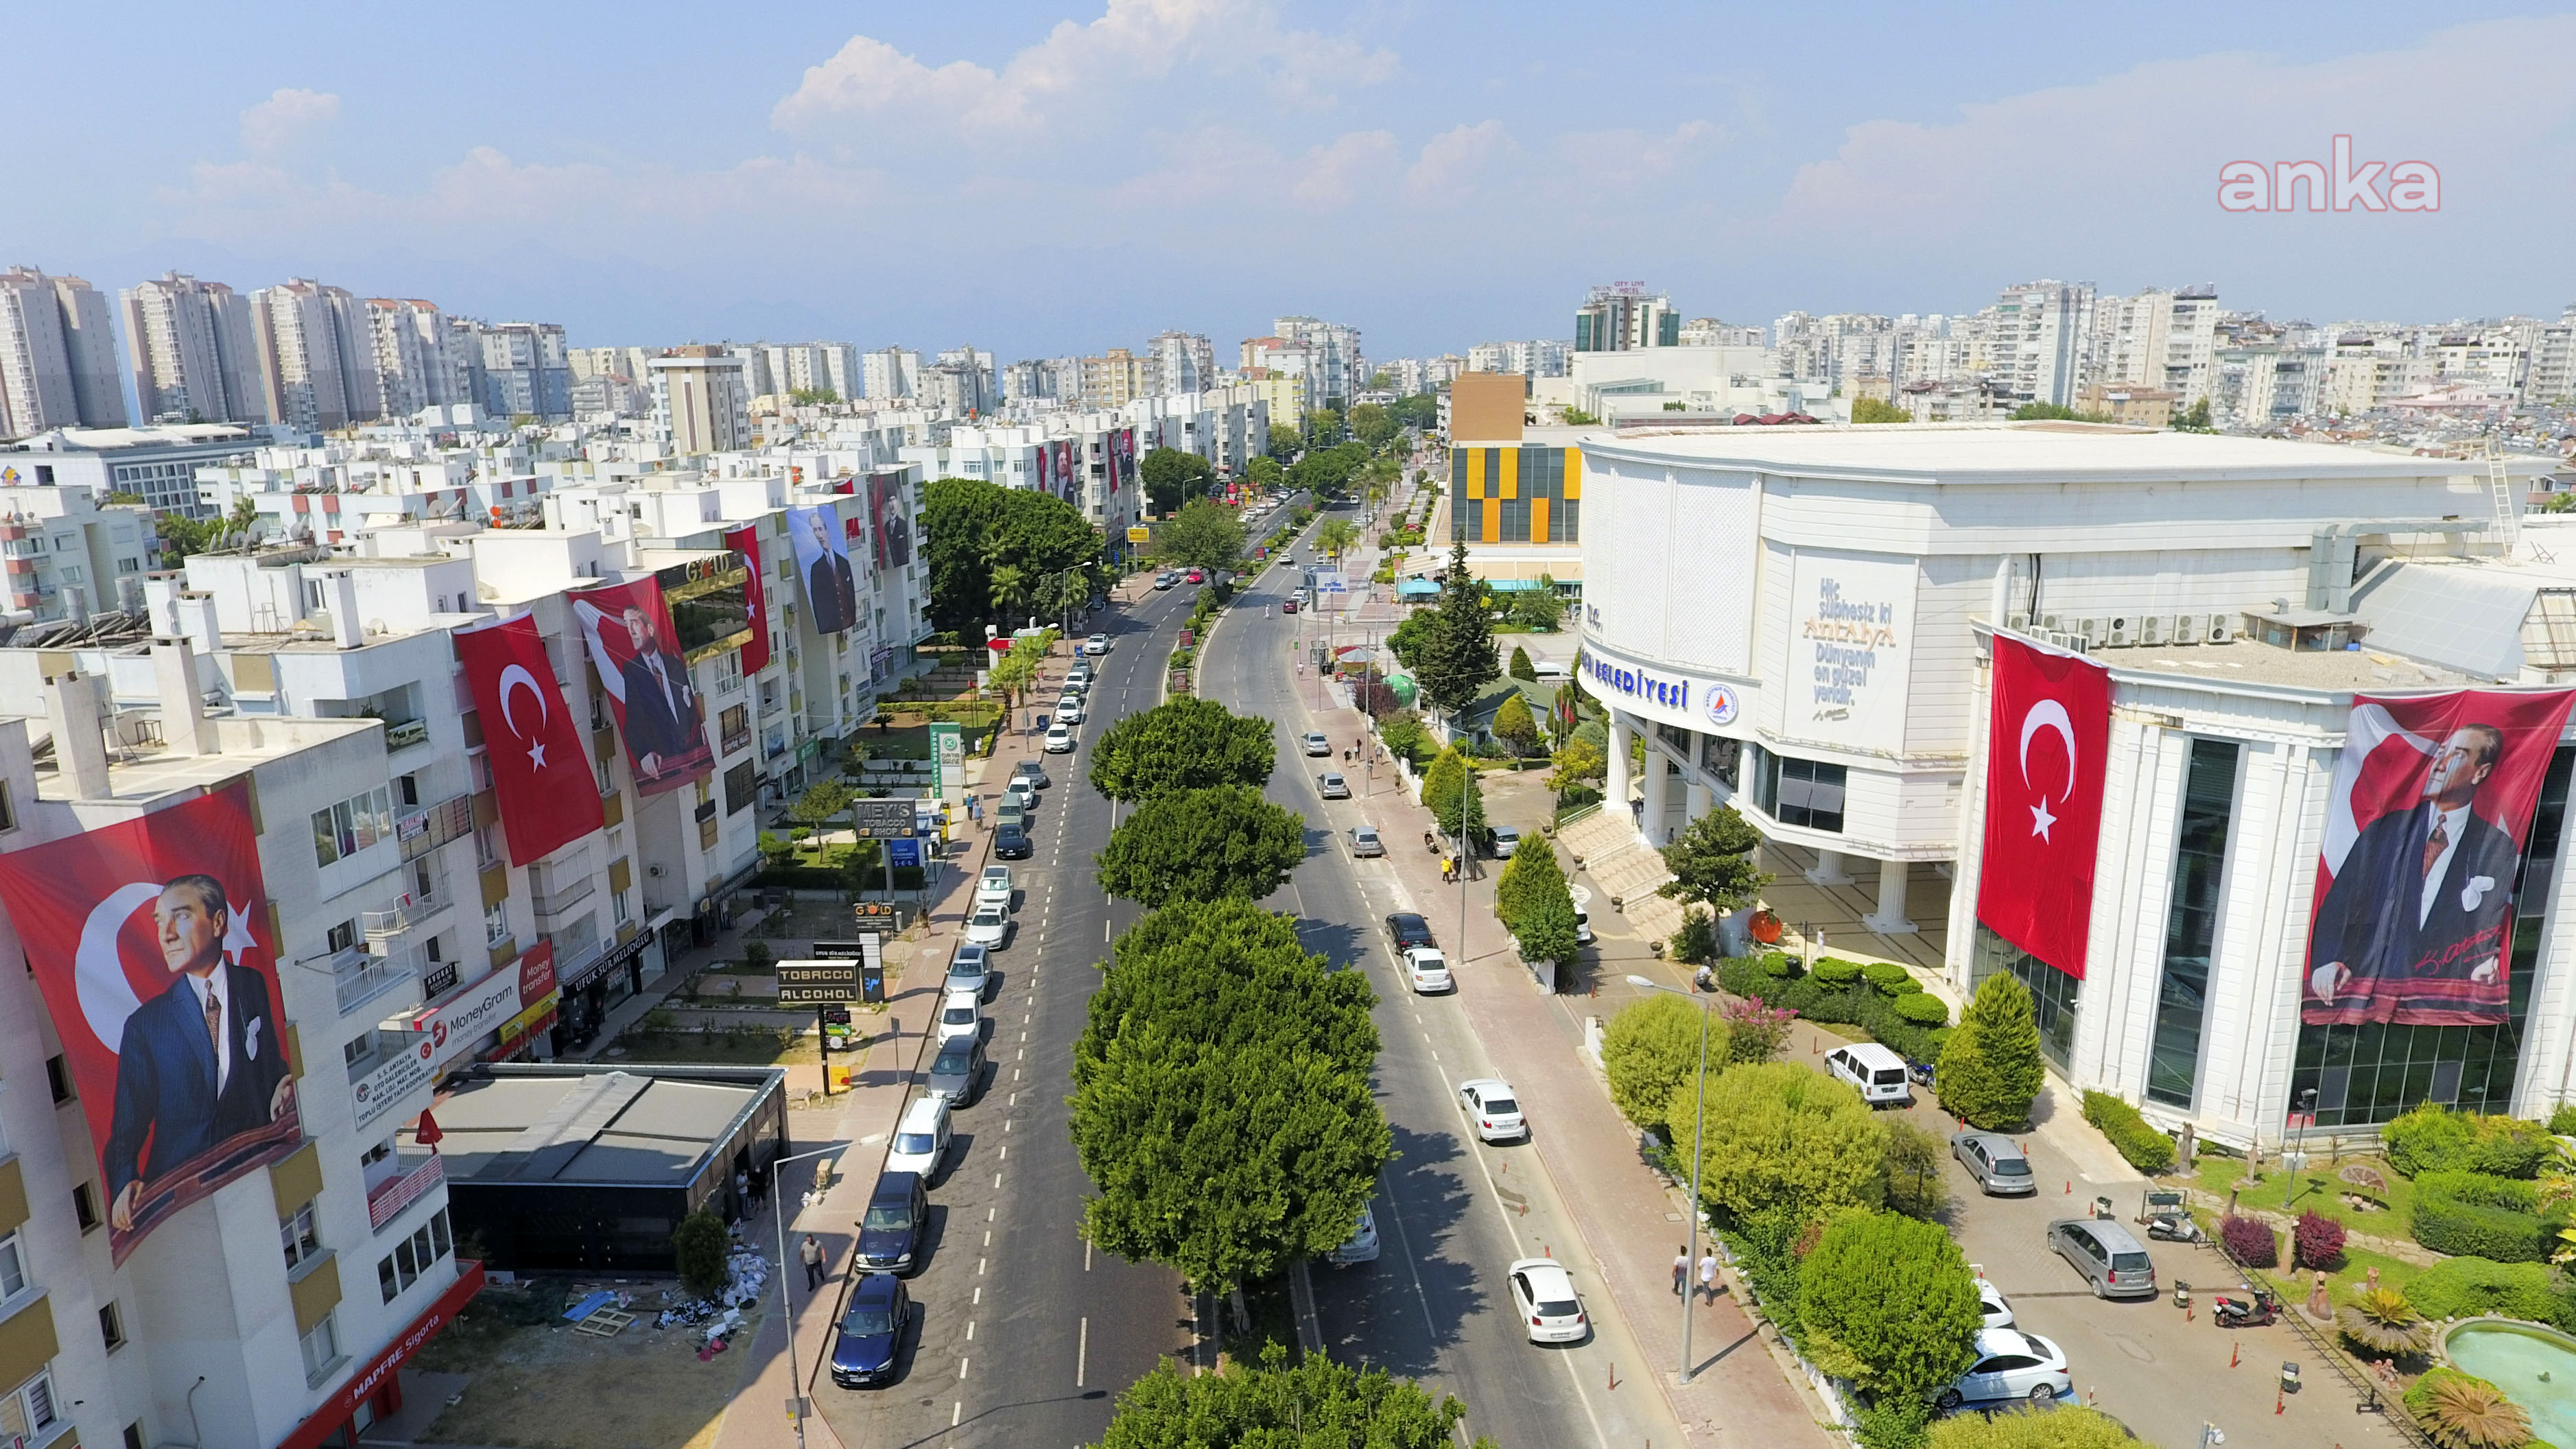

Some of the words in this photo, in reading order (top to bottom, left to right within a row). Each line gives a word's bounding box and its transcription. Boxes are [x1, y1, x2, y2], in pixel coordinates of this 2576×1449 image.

[1820, 578, 1840, 600] Hiç
[1880, 602, 1893, 624] ki
[1594, 658, 1688, 711] BELEDİYESİ
[1814, 665, 1830, 683] en
[1832, 665, 1867, 687] güzel
[857, 803, 910, 818] MEY'S
[863, 819, 906, 827] TOBACCO
[873, 827, 898, 836] SHOP
[427, 965, 453, 986] AVUKAT
[527, 958, 550, 979] Money
[779, 969, 853, 981] TOBACCO
[522, 969, 552, 995] transfer
[575, 969, 598, 991] UFUK
[781, 989, 855, 1000] ALCOHOL
[449, 985, 512, 1035] MoneyGram
[451, 1029, 473, 1047] money
[473, 1011, 497, 1032] transfer
[389, 1053, 412, 1072] ANTALYA
[374, 1080, 385, 1092] OTO
[385, 1059, 418, 1085] GALERİCİLER
[358, 1107, 376, 1123] TOPLU
[353, 1345, 405, 1400] MAPFRE
[405, 1314, 440, 1352] Sigorta
